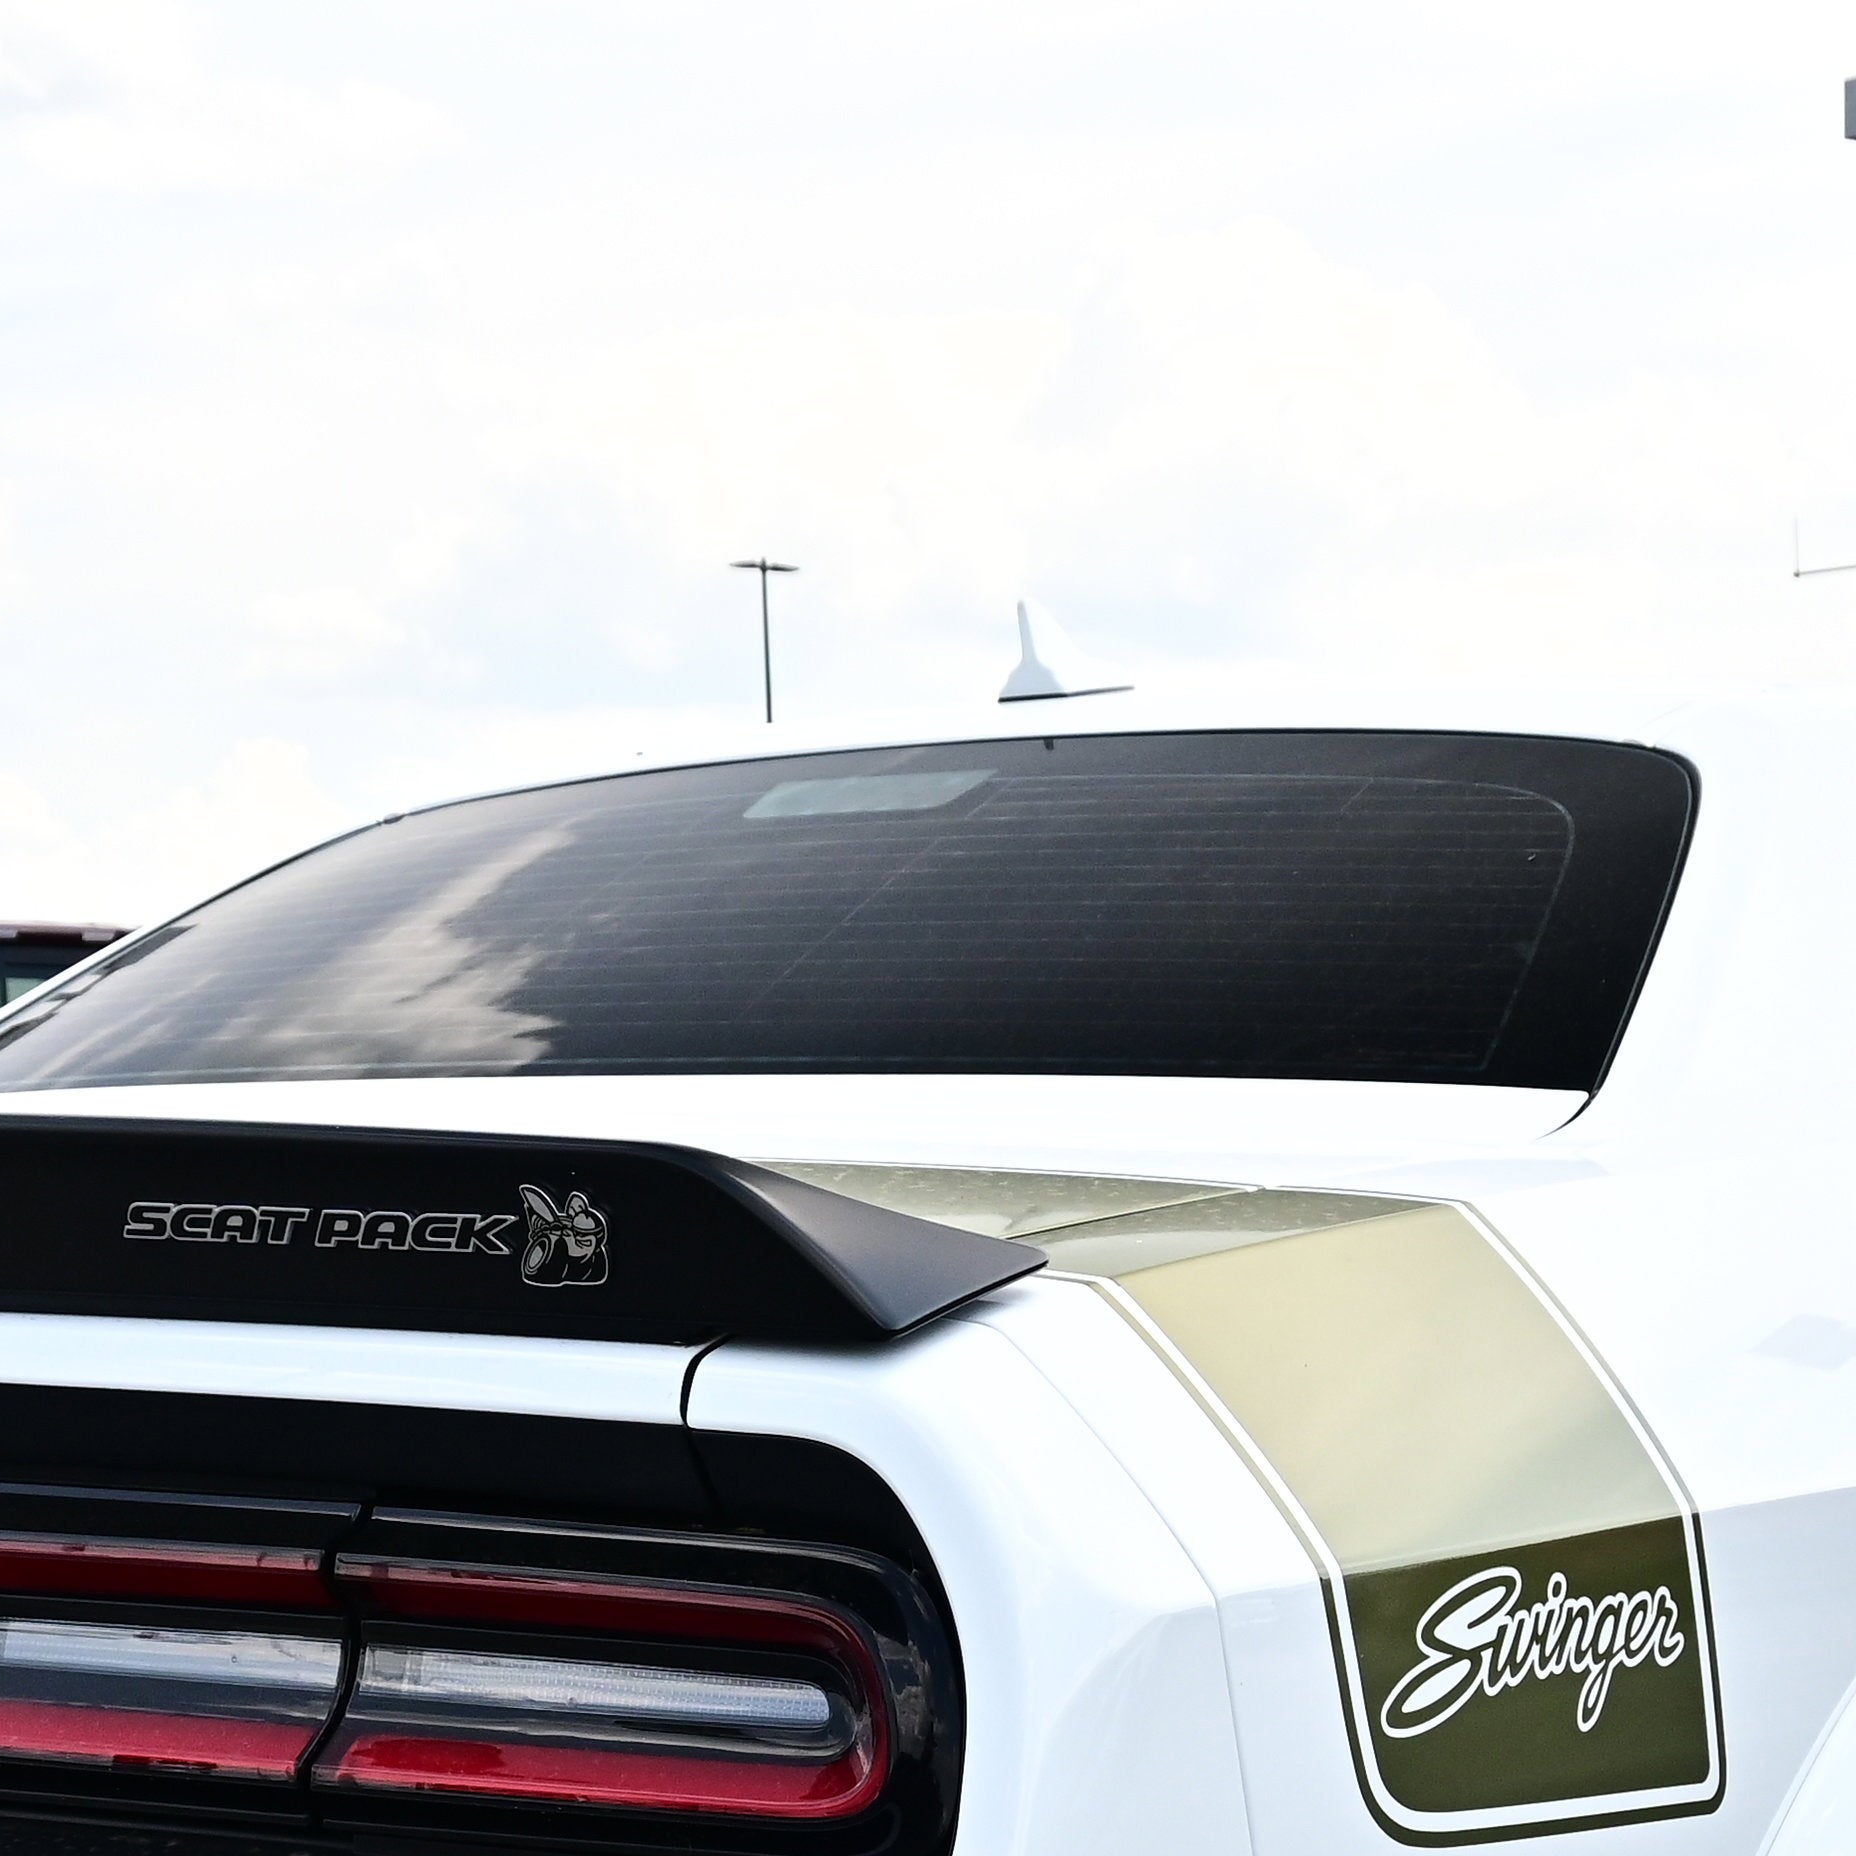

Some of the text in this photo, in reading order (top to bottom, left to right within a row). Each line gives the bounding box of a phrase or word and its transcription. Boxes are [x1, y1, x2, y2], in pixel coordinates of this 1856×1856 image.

[123, 1201, 519, 1255] SCAT PACK
[1380, 1565, 1686, 1738] Swinger
